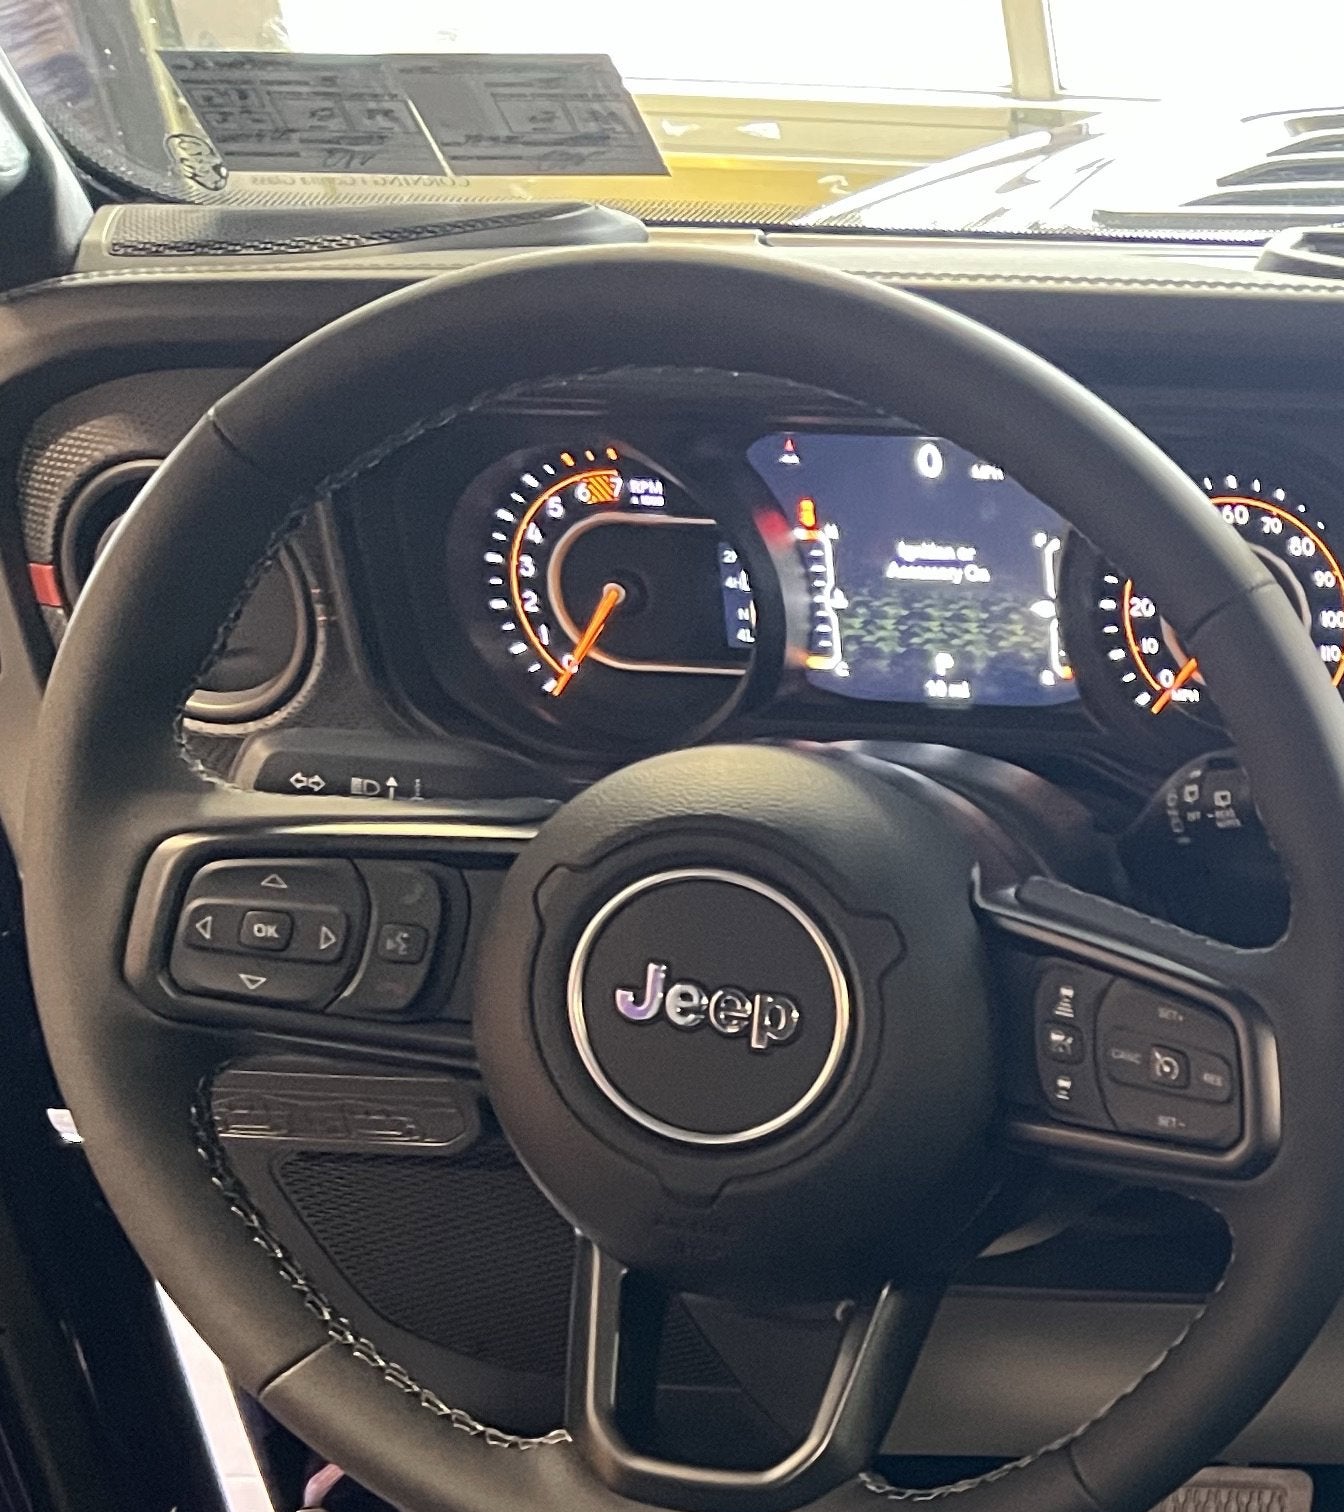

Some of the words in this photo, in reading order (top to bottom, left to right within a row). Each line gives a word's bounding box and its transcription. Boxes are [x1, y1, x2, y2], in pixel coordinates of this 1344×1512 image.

[917, 443, 943, 479] 0
[575, 483, 591, 502] 6
[609, 476, 623, 498] 7
[547, 496, 564, 518] 5
[1222, 505, 1249, 525] 60
[526, 522, 544, 544] 4
[1262, 516, 1283, 534] 70
[1288, 536, 1316, 557] 80
[519, 554, 536, 577] 3
[1313, 570, 1336, 588] 90
[520, 591, 539, 613] 2
[1130, 597, 1156, 618] 20
[1141, 637, 1159, 655] 10
[1321, 645, 1342, 662] 110
[934, 653, 954, 676] P
[1157, 669, 1174, 688] 0
[252, 923, 279, 939] OK
[615, 961, 800, 1050] Jeep
